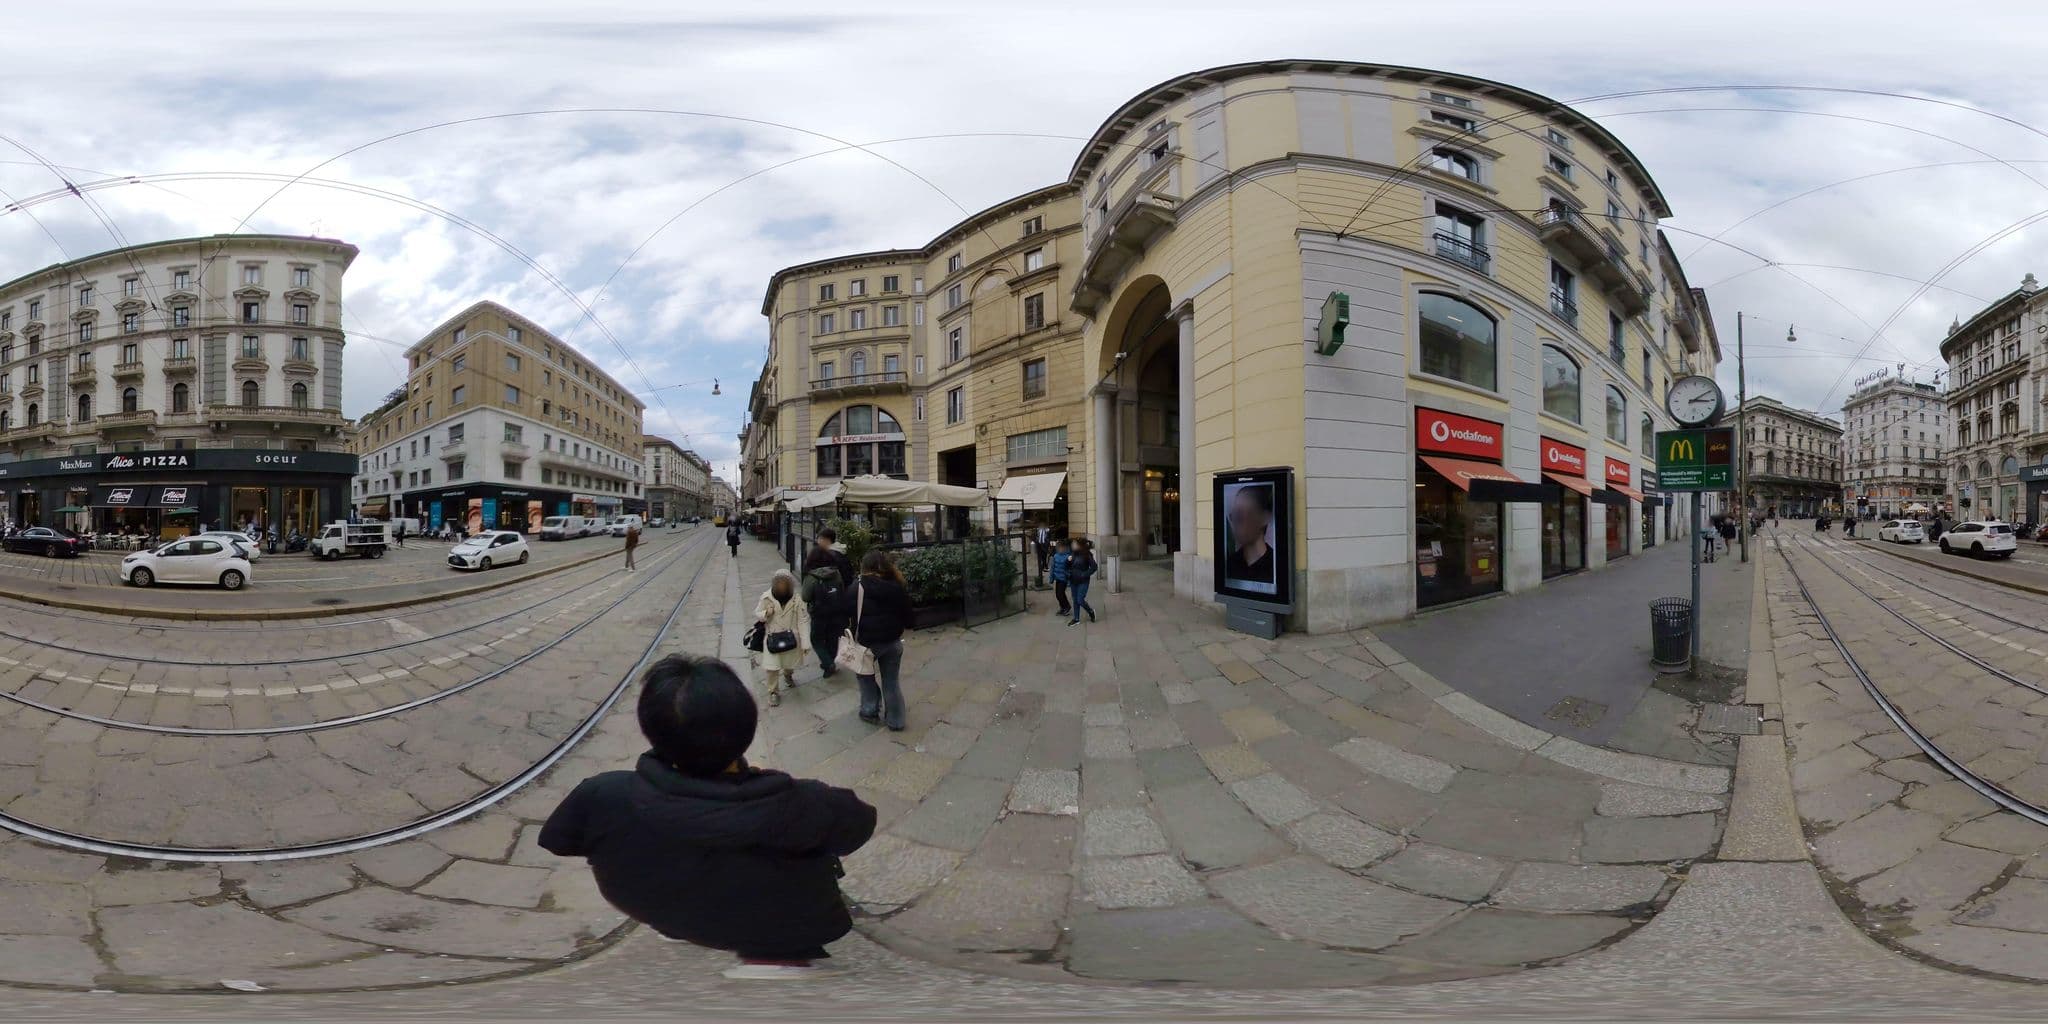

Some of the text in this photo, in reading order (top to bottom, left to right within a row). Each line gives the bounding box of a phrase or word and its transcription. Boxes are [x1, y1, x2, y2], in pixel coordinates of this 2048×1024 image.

[1451, 429, 1494, 446] vodafone
[60, 459, 93, 470] MaxMara
[106, 455, 188, 469] Alice PIZZA
[255, 455, 297, 464] soeur
[1558, 453, 1581, 465] vodafone
